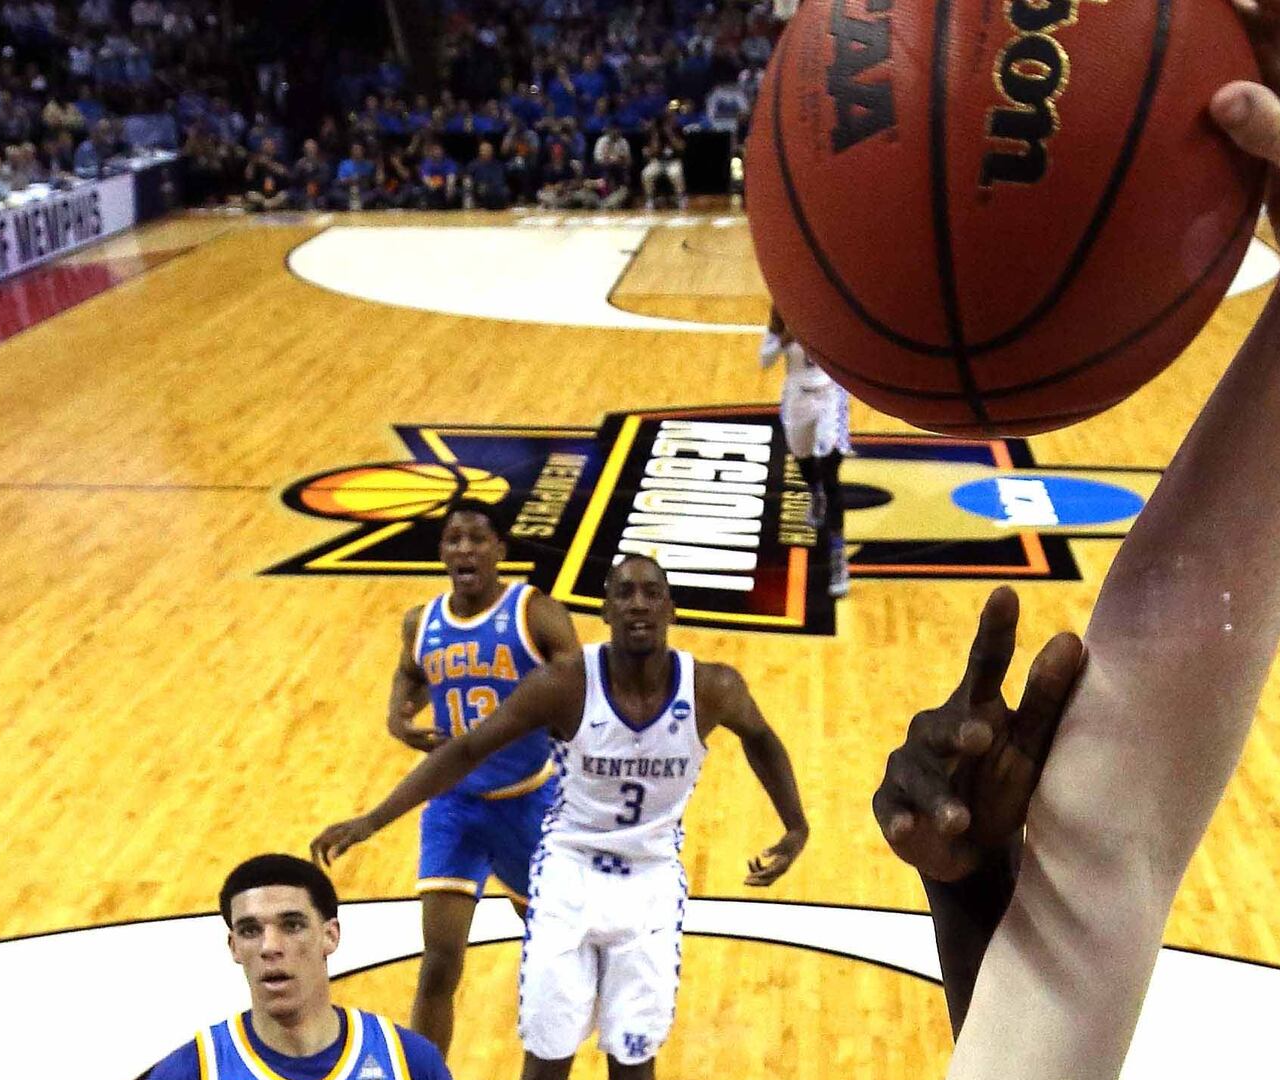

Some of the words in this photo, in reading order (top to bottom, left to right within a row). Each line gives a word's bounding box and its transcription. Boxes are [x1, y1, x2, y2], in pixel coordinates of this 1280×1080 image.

[13, 190, 104, 260] MEMPHIS
[422, 641, 519, 686] UCLA
[581, 754, 689, 778] KENTUCKY
[615, 781, 646, 825] 3
